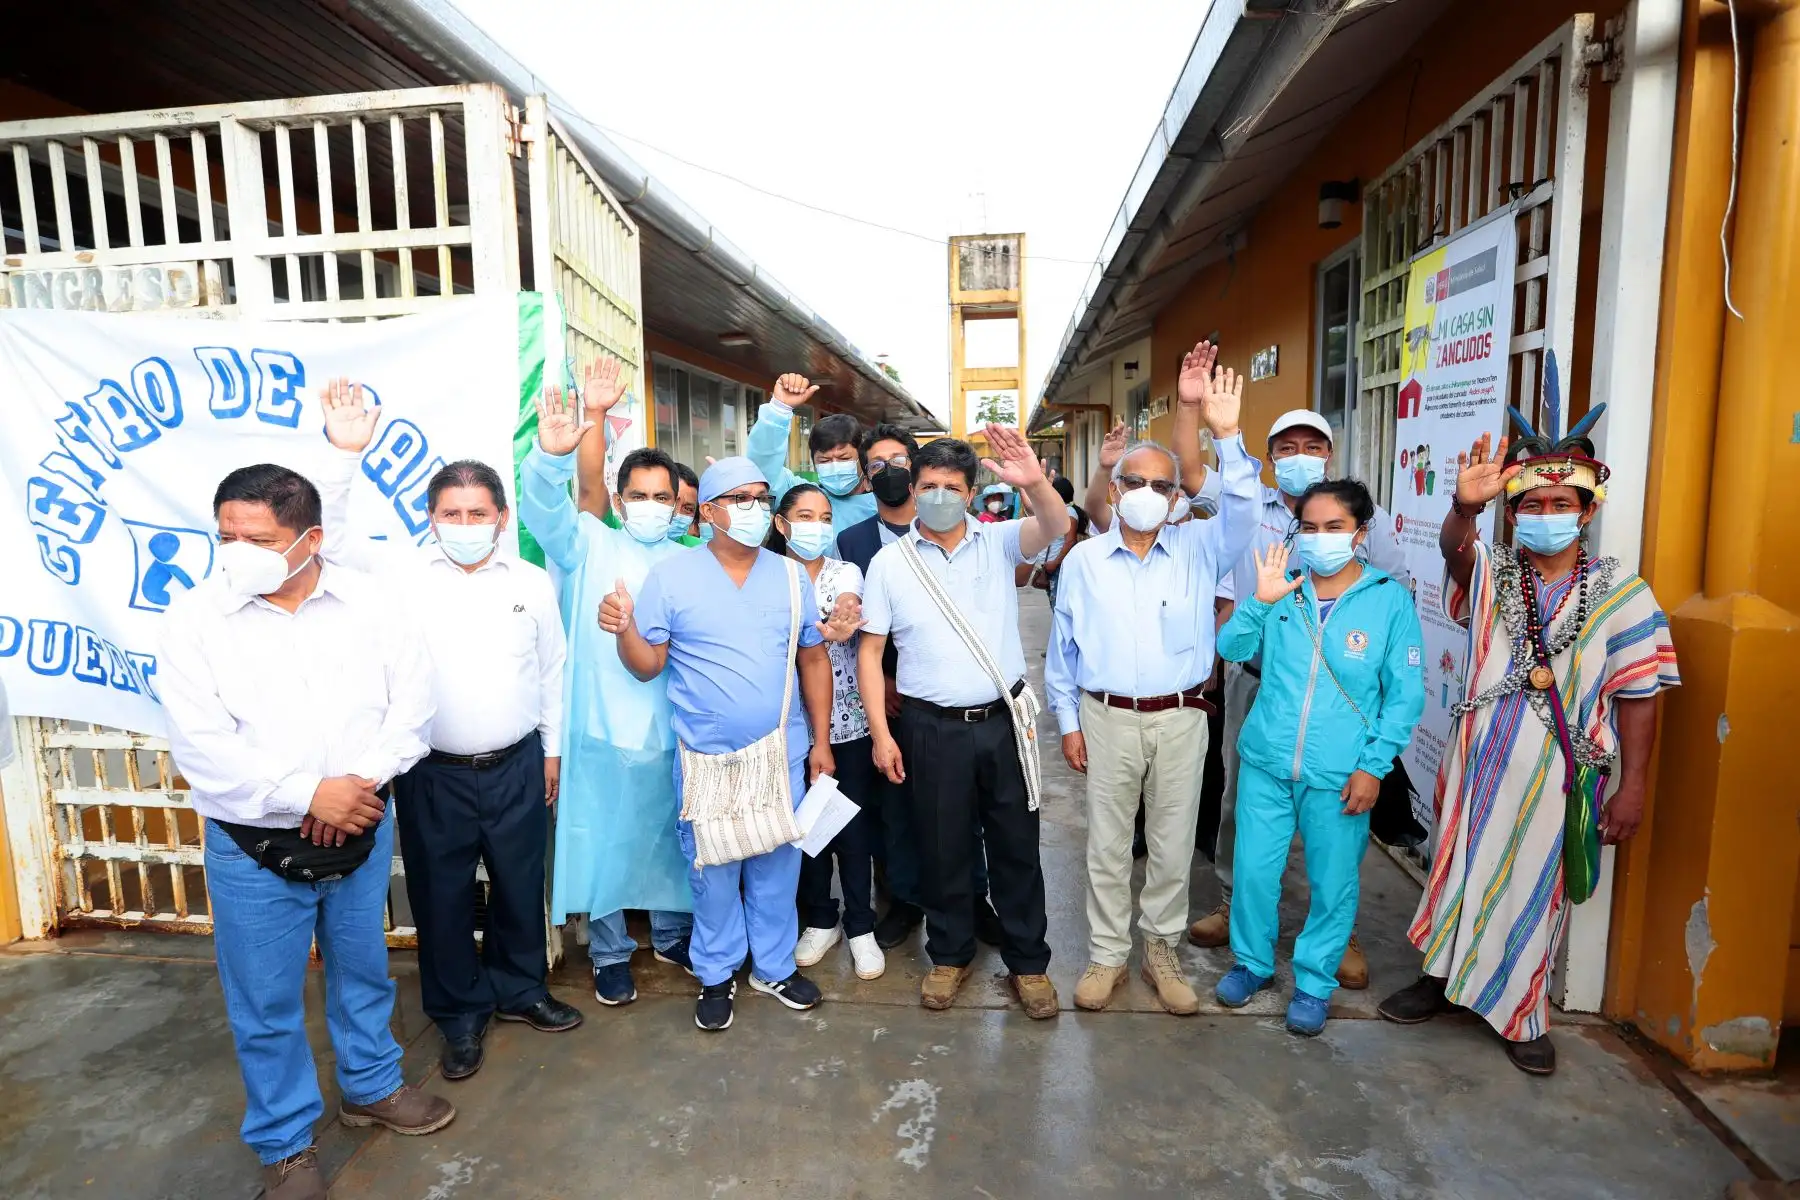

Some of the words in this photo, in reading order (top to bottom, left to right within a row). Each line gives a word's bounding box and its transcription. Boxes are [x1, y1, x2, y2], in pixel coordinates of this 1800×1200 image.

[10, 267, 194, 312] INGRESO
[1438, 319, 1448, 340] MI
[1450, 310, 1475, 337] CASA
[1477, 304, 1494, 330] SIN
[1436, 331, 1493, 369] ZANCUDOS
[193, 346, 305, 429] DE
